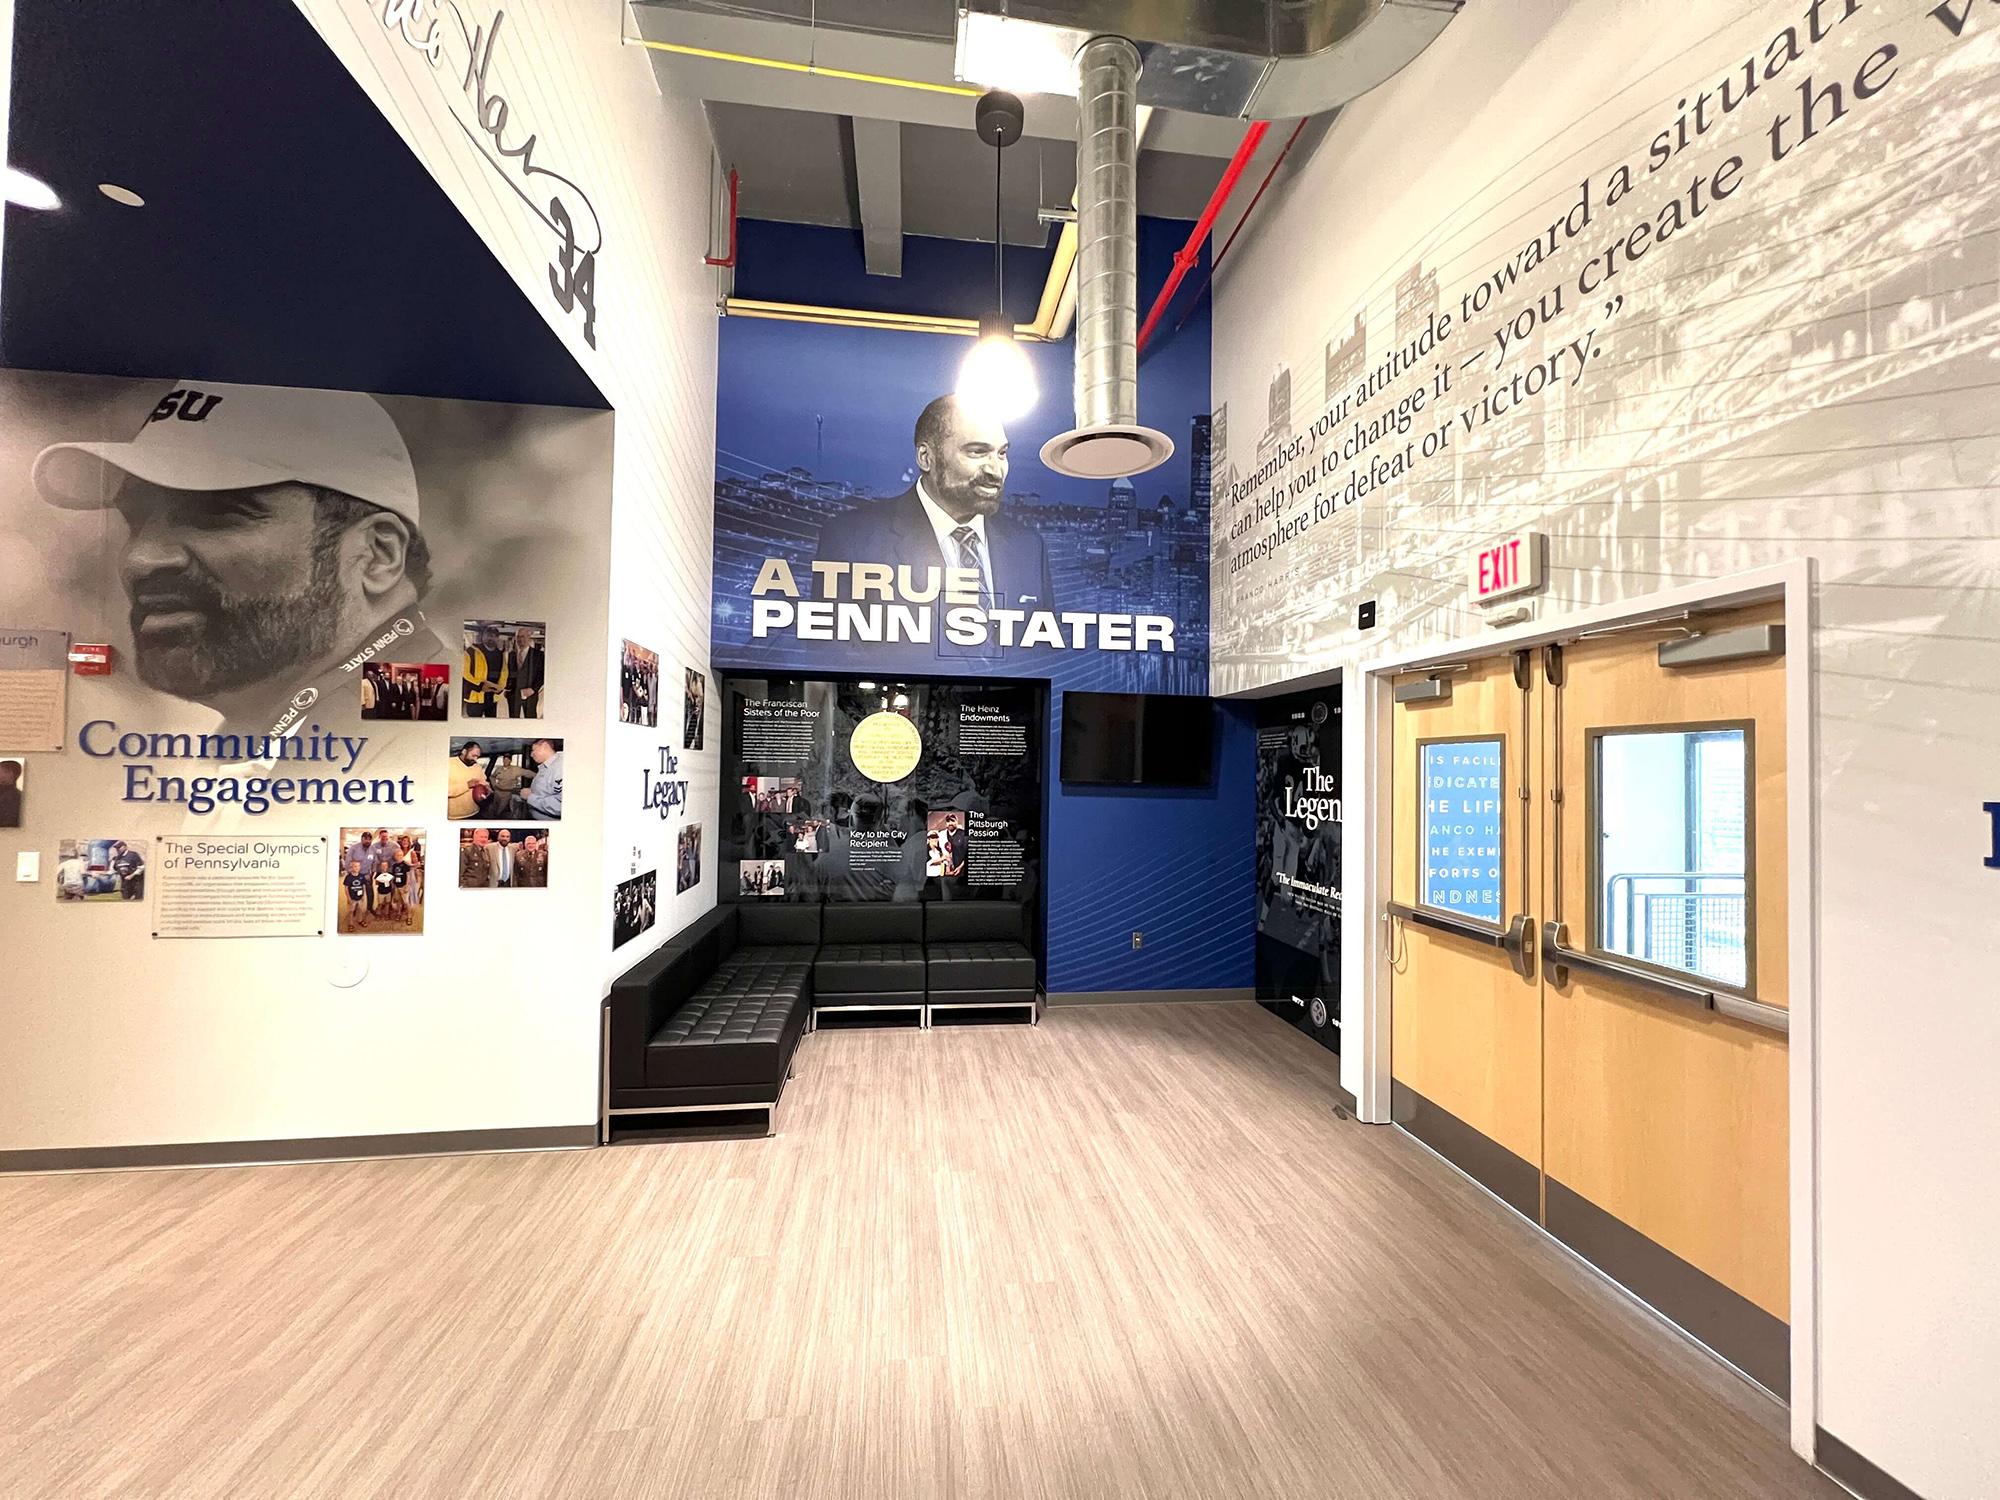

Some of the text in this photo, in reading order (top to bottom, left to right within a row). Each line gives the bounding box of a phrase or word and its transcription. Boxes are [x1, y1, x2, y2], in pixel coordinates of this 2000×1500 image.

[1230, 512, 1252, 540] can
[1255, 486, 1284, 525] help
[1288, 465, 1317, 509] you
[1321, 450, 1339, 477] to
[1344, 387, 1426, 461] change
[1433, 363, 1453, 401] it
[1494, 284, 1565, 371] you
[1578, 155, 1744, 294] create
[1767, 43, 1899, 161] the
[1309, 395, 1350, 454] your
[1356, 312, 1452, 408] attitude
[1460, 177, 1593, 323] toward
[1606, 164, 1634, 207] a
[1230, 513, 1309, 574] atmosphere
[1313, 491, 1340, 526] for
[1344, 442, 1415, 506] defeat
[1422, 419, 1453, 458] or
[1479, 539, 1521, 595] EXIT
[750, 558, 980, 605] A TRUE
[752, 600, 1176, 653] PENN STATER
[0, 635, 39, 649] urgh
[373, 629, 399, 652] PENN
[744, 698, 808, 708] The Franciscan
[960, 704, 1000, 713] The Heinz
[269, 707, 299, 738] PENN
[743, 708, 820, 718] Sisters of the Poor
[960, 713, 1010, 722] Endowments
[79, 720, 369, 772] Community
[658, 746, 678, 775] The
[1302, 765, 1334, 792] The
[121, 764, 414, 815] Engagement
[643, 769, 689, 820] Legacy
[968, 810, 984, 819] The
[1284, 786, 1342, 830] Legen
[968, 820, 1009, 829] Pittsburgh
[968, 829, 999, 837] Passion
[1430, 825, 1500, 835] ANCO H
[850, 830, 866, 840] Key
[891, 830, 907, 840] City
[850, 840, 889, 848] Recipient
[165, 842, 320, 857] The Special Olympics
[1458, 847, 1500, 857] EXEM
[164, 857, 280, 872] of Pennsylvania
